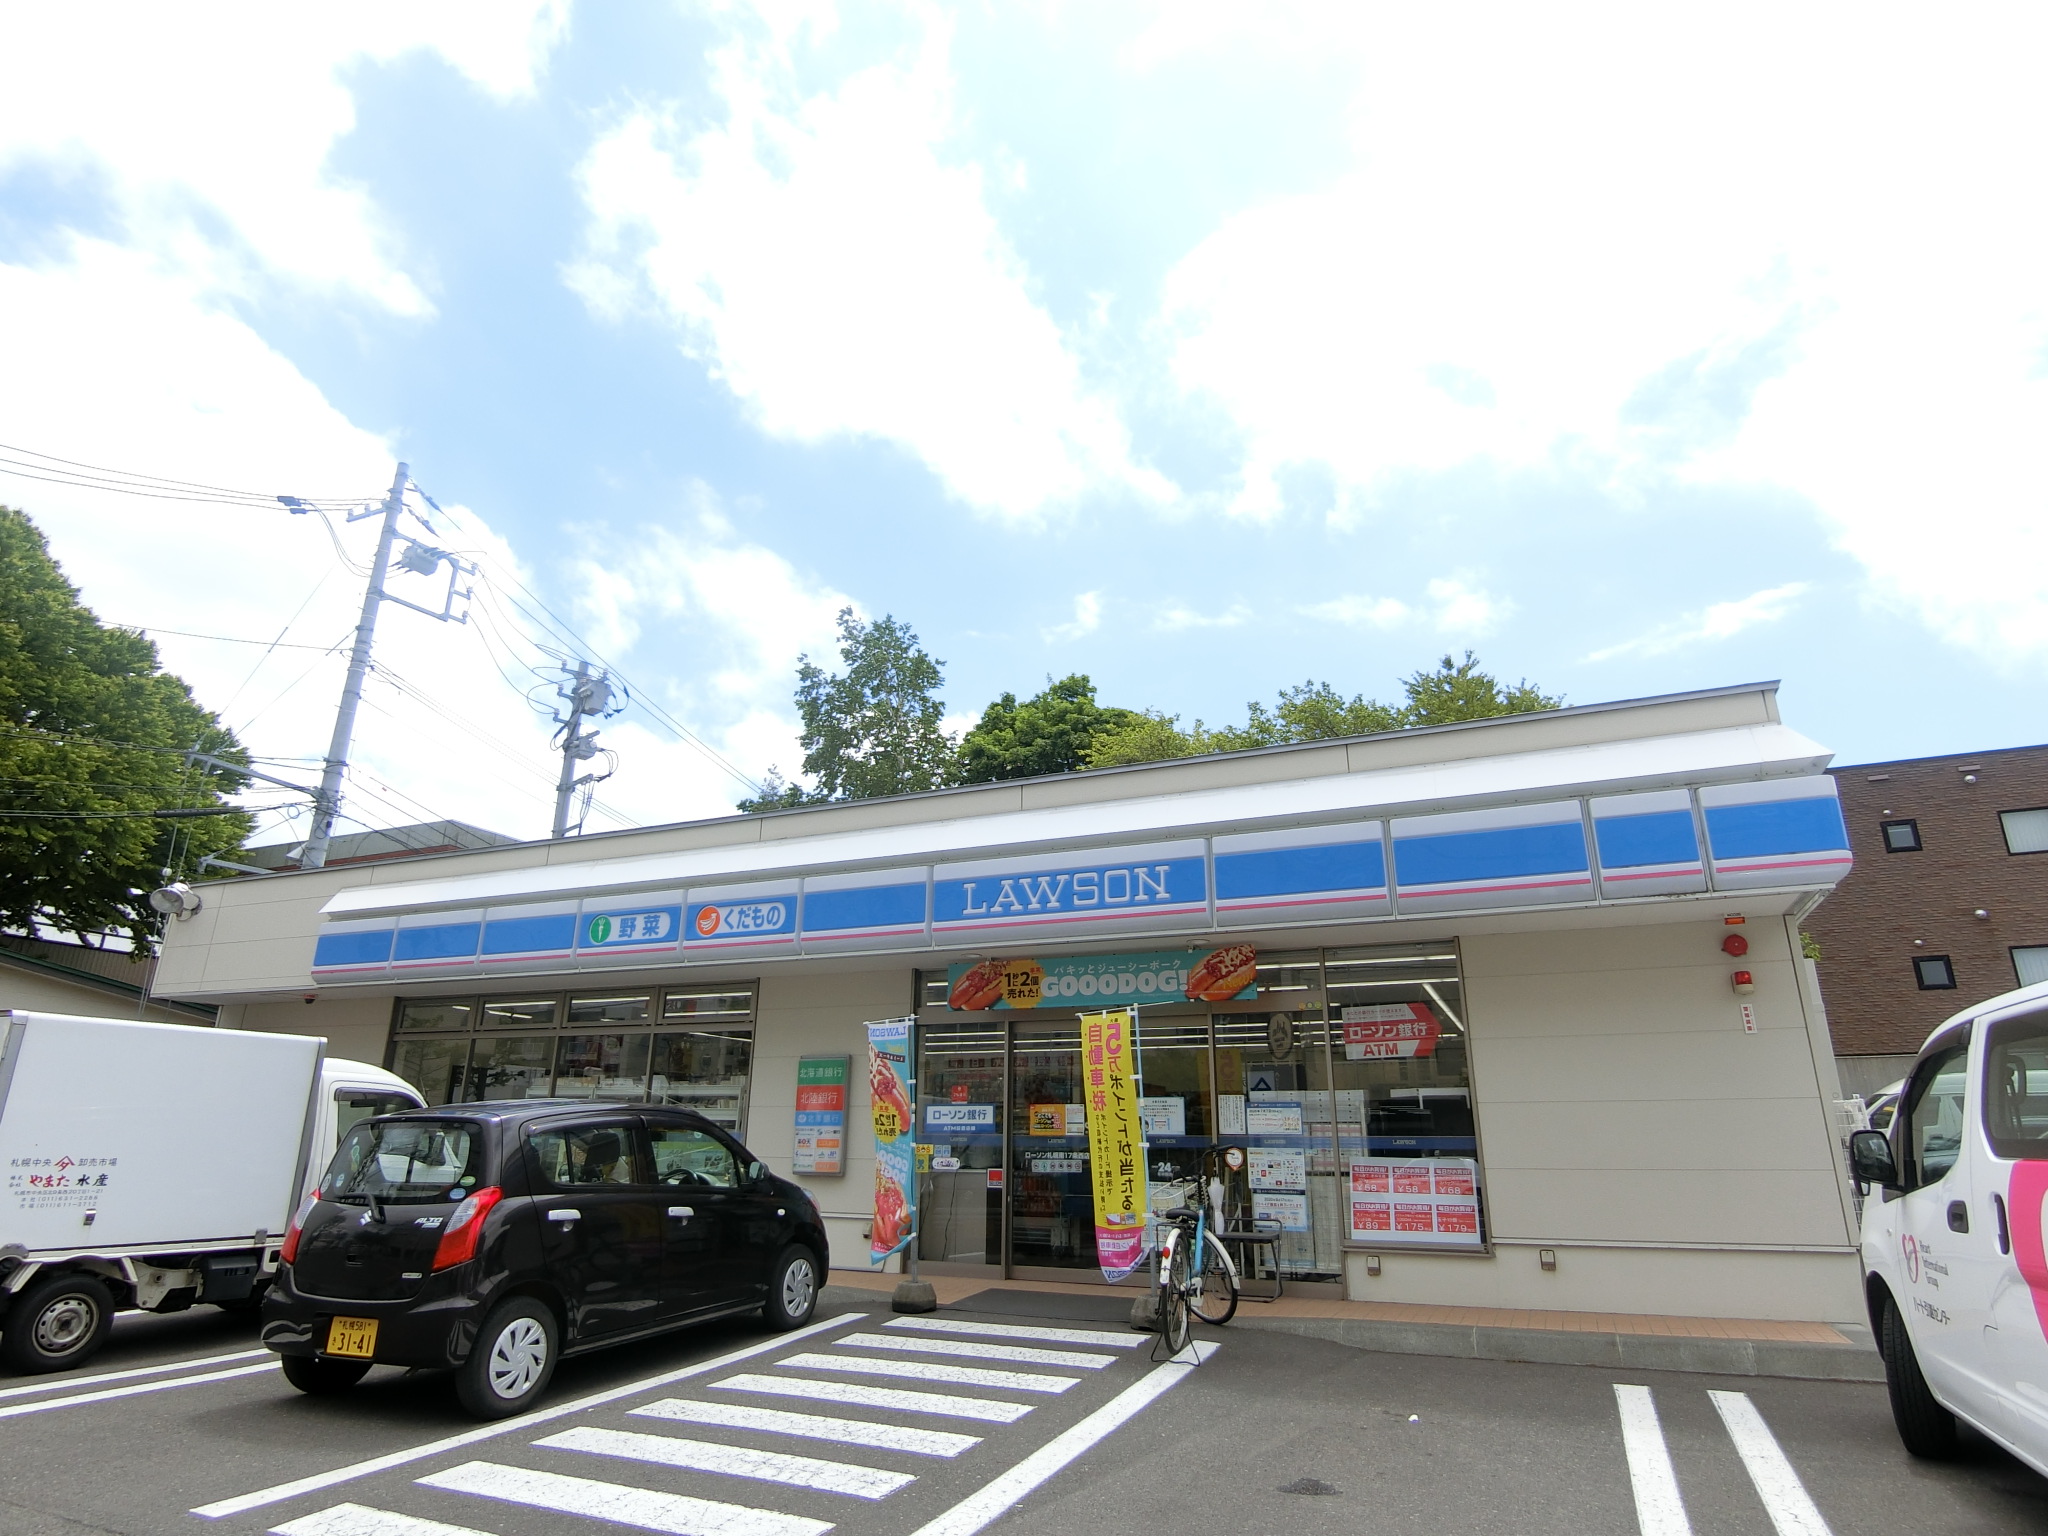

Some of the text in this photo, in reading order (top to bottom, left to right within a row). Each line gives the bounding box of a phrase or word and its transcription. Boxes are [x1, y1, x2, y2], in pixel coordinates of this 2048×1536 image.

[961, 864, 1171, 916] LAWSON
[723, 904, 781, 931] くだもの
[618, 914, 661, 939] 野菜
[1040, 969, 1188, 997] GOOODOG!
[1007, 988, 1039, 999] 売れた!
[1348, 1022, 1427, 1039] ローソン銀行
[1363, 1042, 1399, 1057] ATM
[799, 1067, 843, 1078] 北海道銀行
[800, 1092, 838, 1104] 北陸銀行
[932, 1109, 988, 1121] ローソン銀行
[10, 1157, 52, 1168] 札幌中央
[77, 1157, 118, 1167] 卸売市場
[1157, 1161, 1172, 1172] 24
[29, 1173, 109, 1188] やまた 水産
[1357, 1184, 1377, 1192] ¥58
[1397, 1185, 1419, 1193] ¥58
[1440, 1186, 1461, 1194] ¥68
[1357, 1221, 1379, 1230] ¥89
[1396, 1222, 1424, 1231] ¥175
[1439, 1224, 1467, 1233] ¥179
[337, 1332, 372, 1354] 31-41
